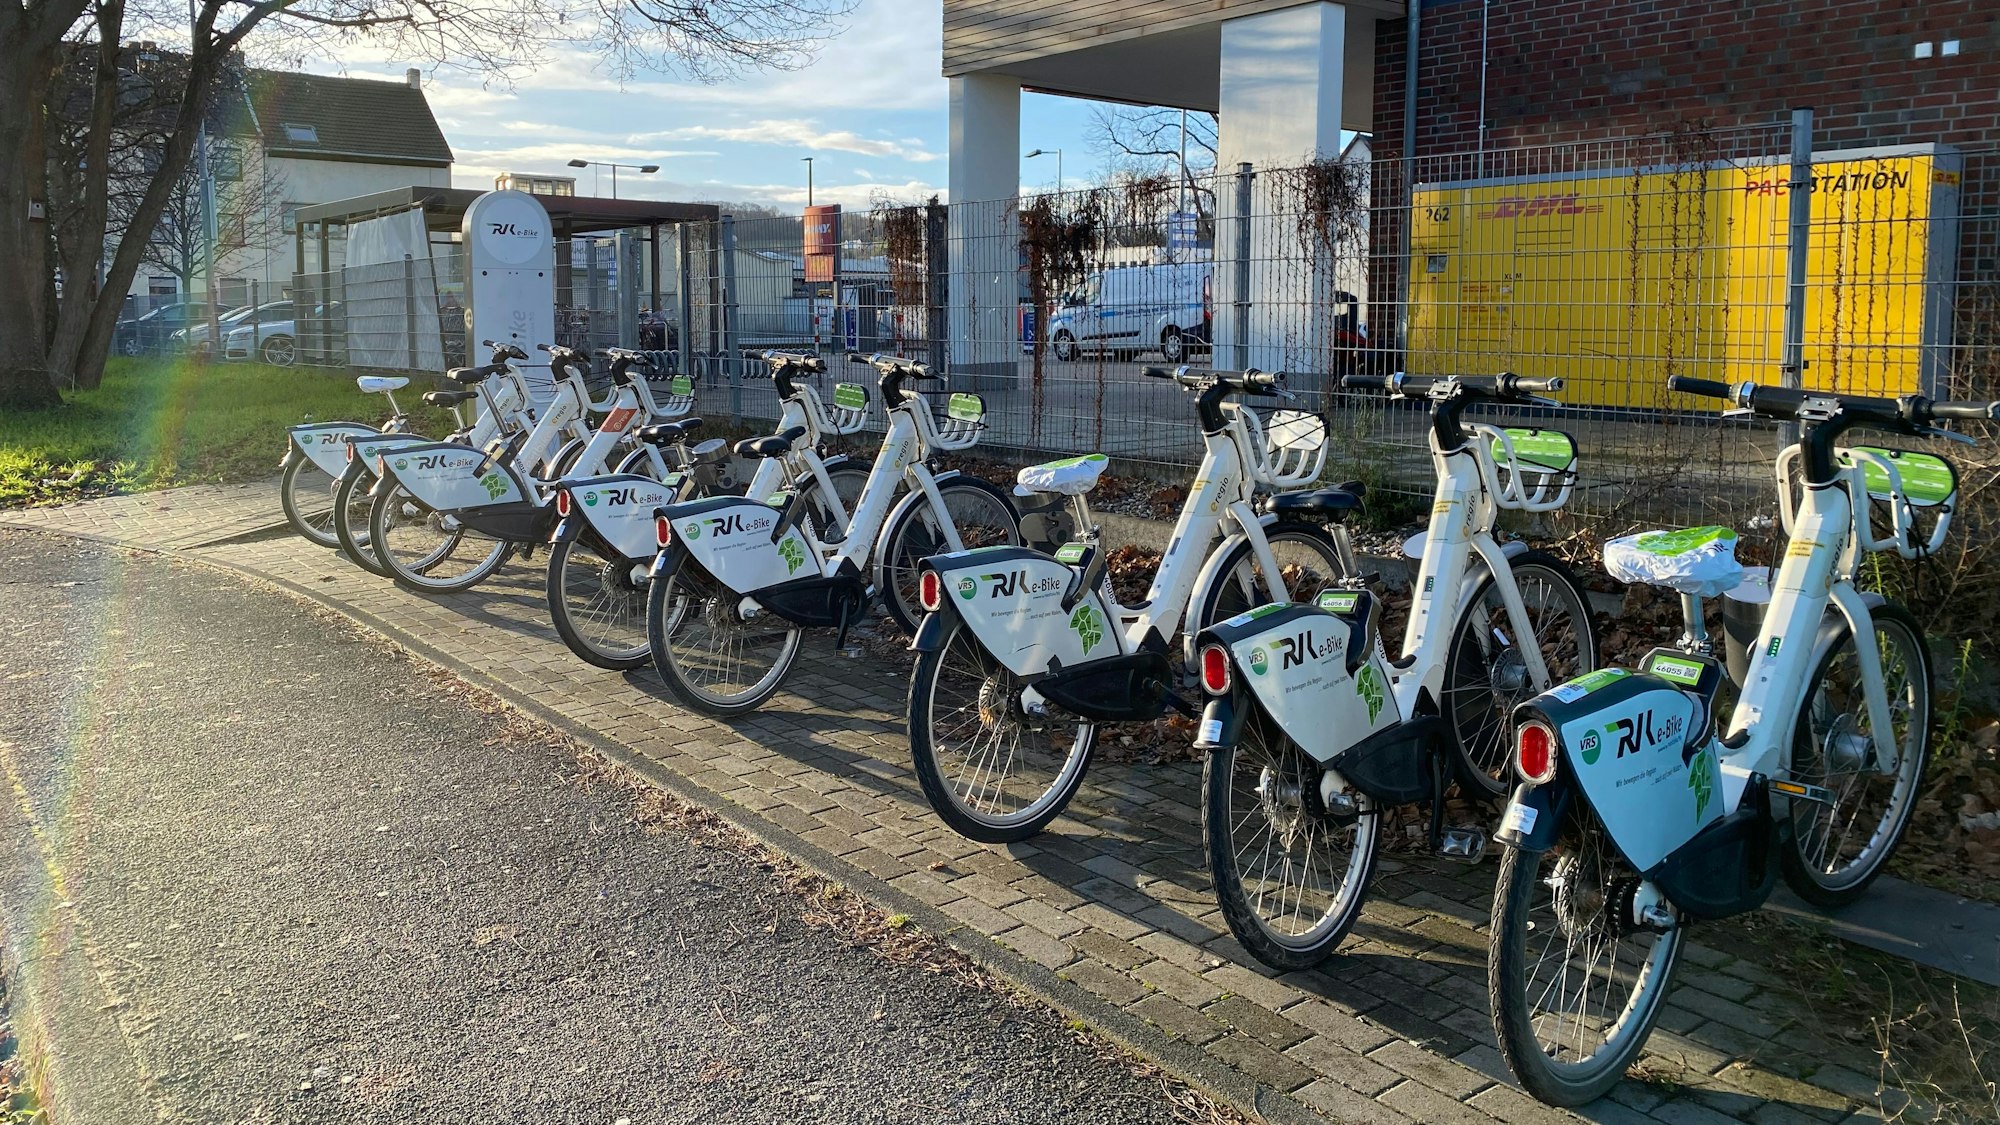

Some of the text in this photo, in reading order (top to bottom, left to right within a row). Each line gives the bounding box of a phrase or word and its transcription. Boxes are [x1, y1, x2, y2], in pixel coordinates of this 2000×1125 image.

[1492, 193, 1585, 218] DHL
[448, 458, 474, 467] e-Bike
[640, 493, 663, 504] e-Bike
[745, 518, 770, 531] e-Bike
[957, 581, 973, 591] VRS
[1032, 576, 1061, 594] e-Bike
[1248, 652, 1264, 665] VRS
[1319, 634, 1343, 658] e-Bike
[1654, 664, 1682, 676] 46055
[1579, 736, 1598, 751] VRS
[1656, 714, 1683, 744] e-Bike
